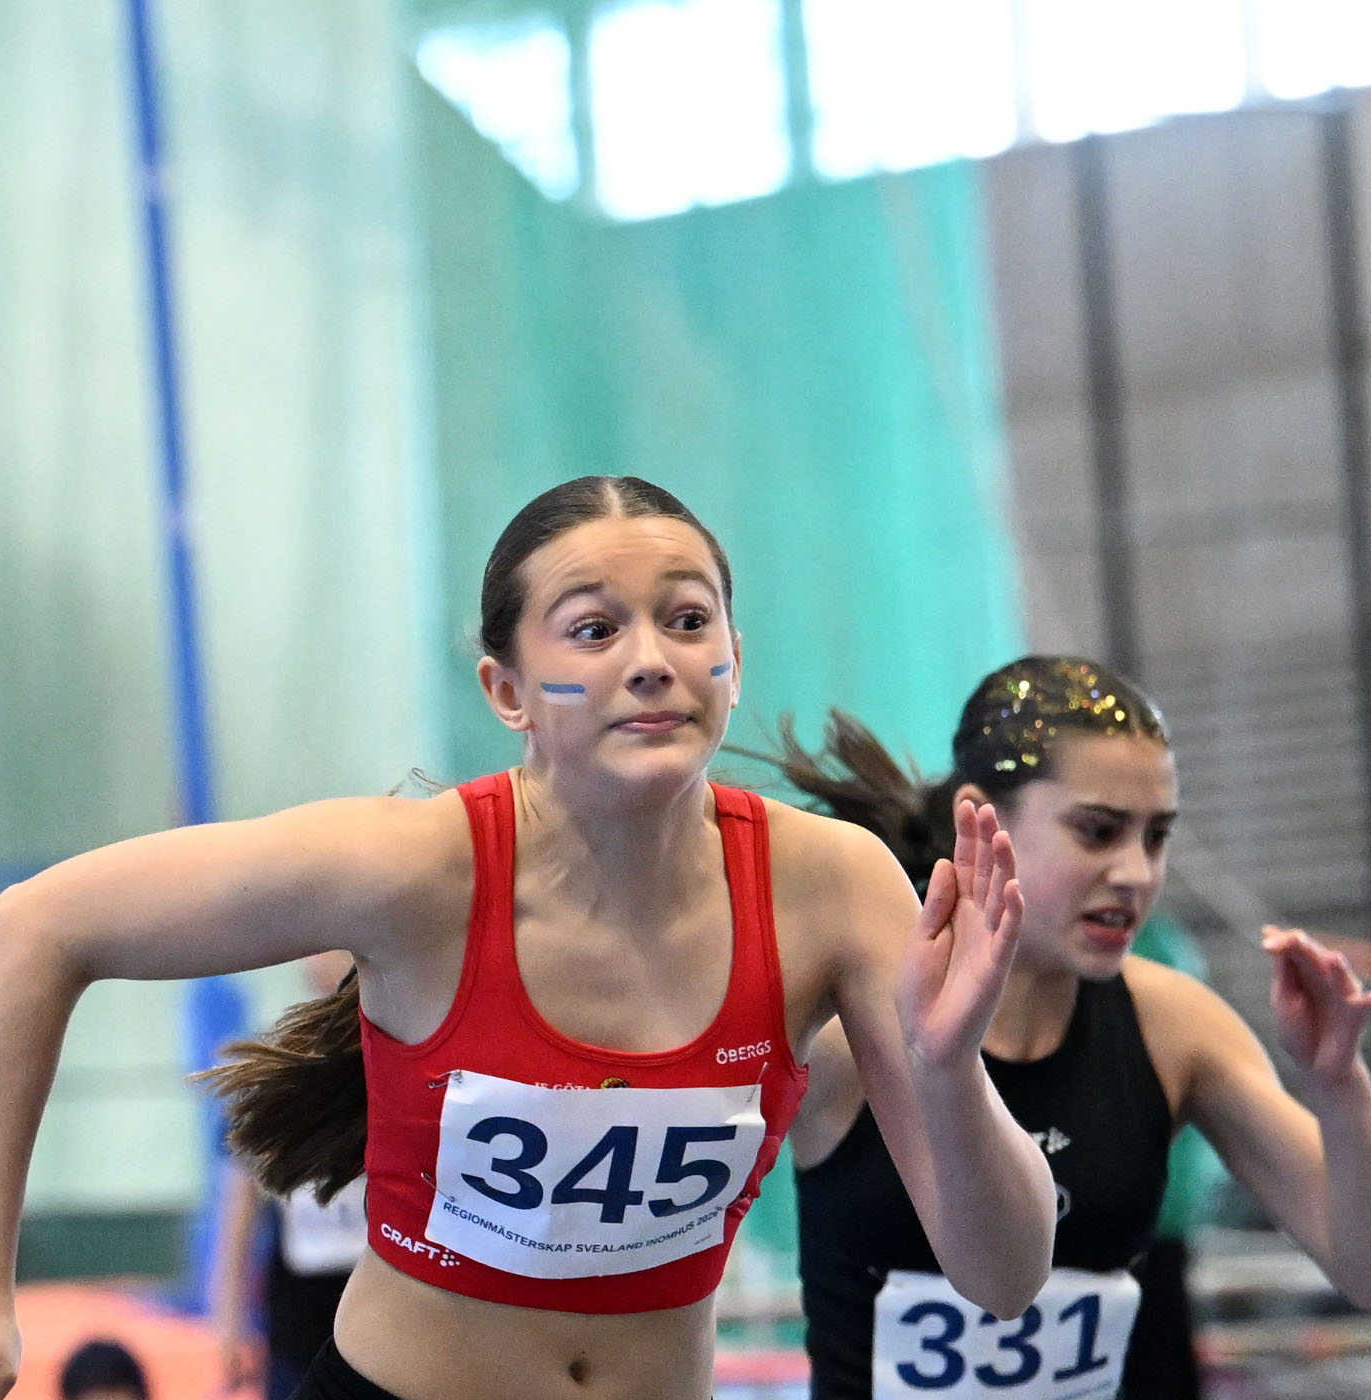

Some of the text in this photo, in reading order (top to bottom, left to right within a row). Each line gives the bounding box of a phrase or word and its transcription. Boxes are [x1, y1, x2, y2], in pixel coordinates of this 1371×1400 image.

[716, 1040, 771, 1064] ÖBERGS
[461, 1116, 737, 1224] 345
[381, 1223, 440, 1259] CRAFT
[443, 1202, 572, 1252] REGIONMÄSTERSKAP
[576, 1242, 643, 1253] SVEALAND
[645, 1221, 694, 1246] INOMHUS
[896, 1293, 1108, 1390] 331
